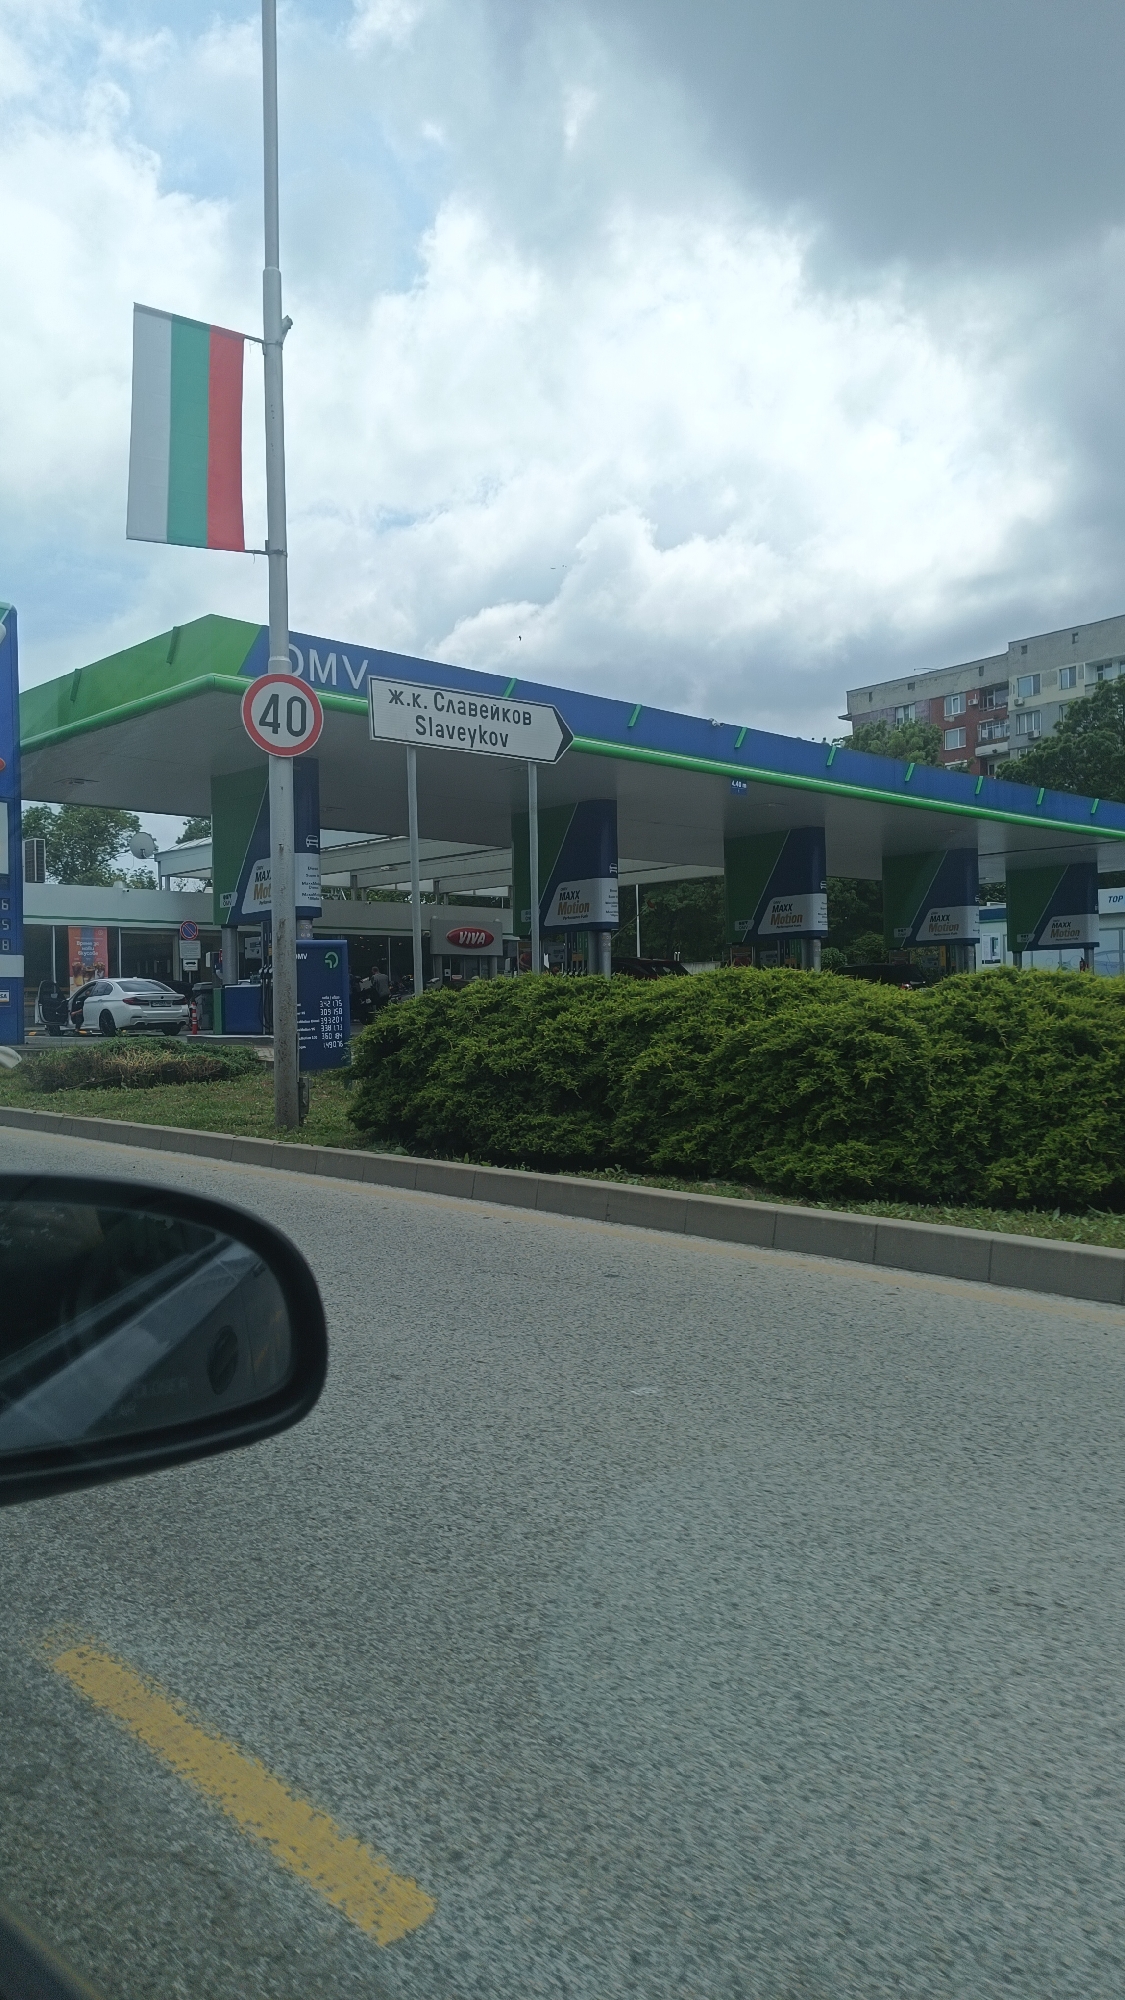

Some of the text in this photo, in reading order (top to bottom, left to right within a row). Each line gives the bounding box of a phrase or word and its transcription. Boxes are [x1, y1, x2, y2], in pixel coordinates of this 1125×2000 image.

[388, 688, 532, 726] ж.к. Славейков
[258, 693, 307, 738] 40
[415, 714, 509, 748] Slaveykov
[253, 882, 272, 901] Mot
[559, 889, 581, 901] MAXX
[1108, 895, 1124, 904] TOP
[557, 900, 590, 916] Motion
[771, 903, 794, 914] MAXX
[770, 912, 803, 926] Motion
[929, 914, 950, 923] MAXX
[1051, 921, 1072, 929] MAXX
[928, 922, 960, 933] Motion
[1050, 928, 1080, 939] Motion
[459, 931, 486, 945] VIVA
